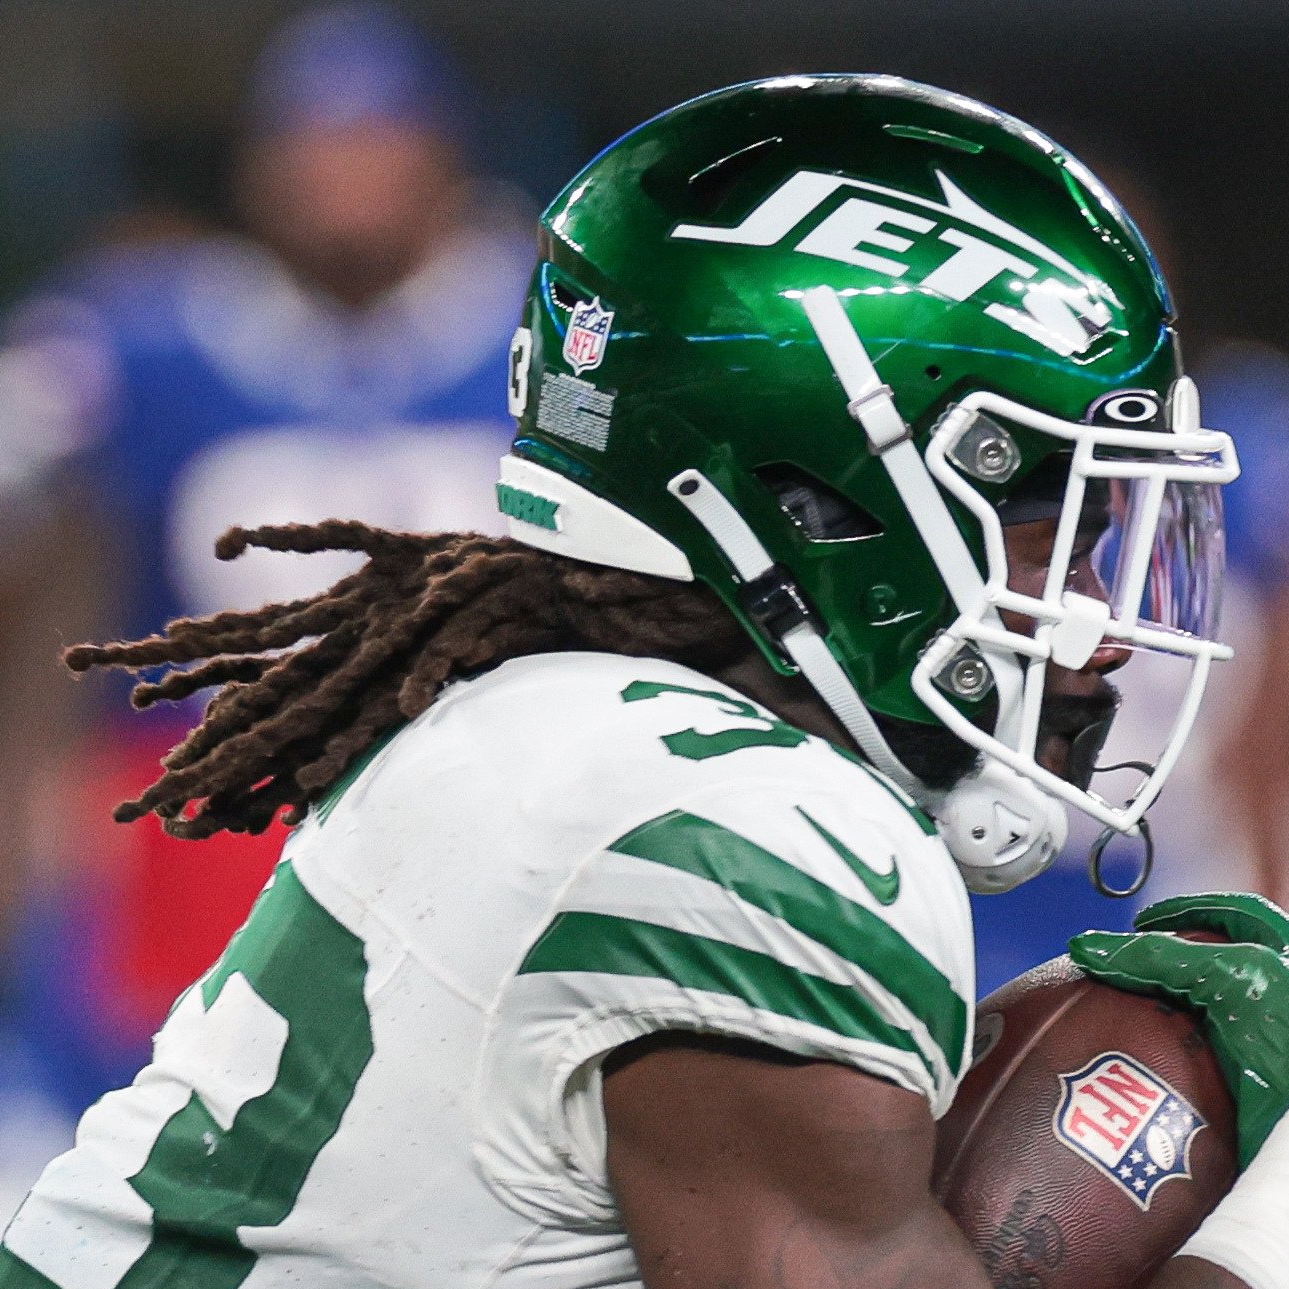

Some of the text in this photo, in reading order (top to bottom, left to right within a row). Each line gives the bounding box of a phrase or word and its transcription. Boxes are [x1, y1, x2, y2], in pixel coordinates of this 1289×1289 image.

[669, 169, 1128, 365] JETS
[568, 327, 599, 362] NFL
[1068, 1063, 1160, 1151] NFL
